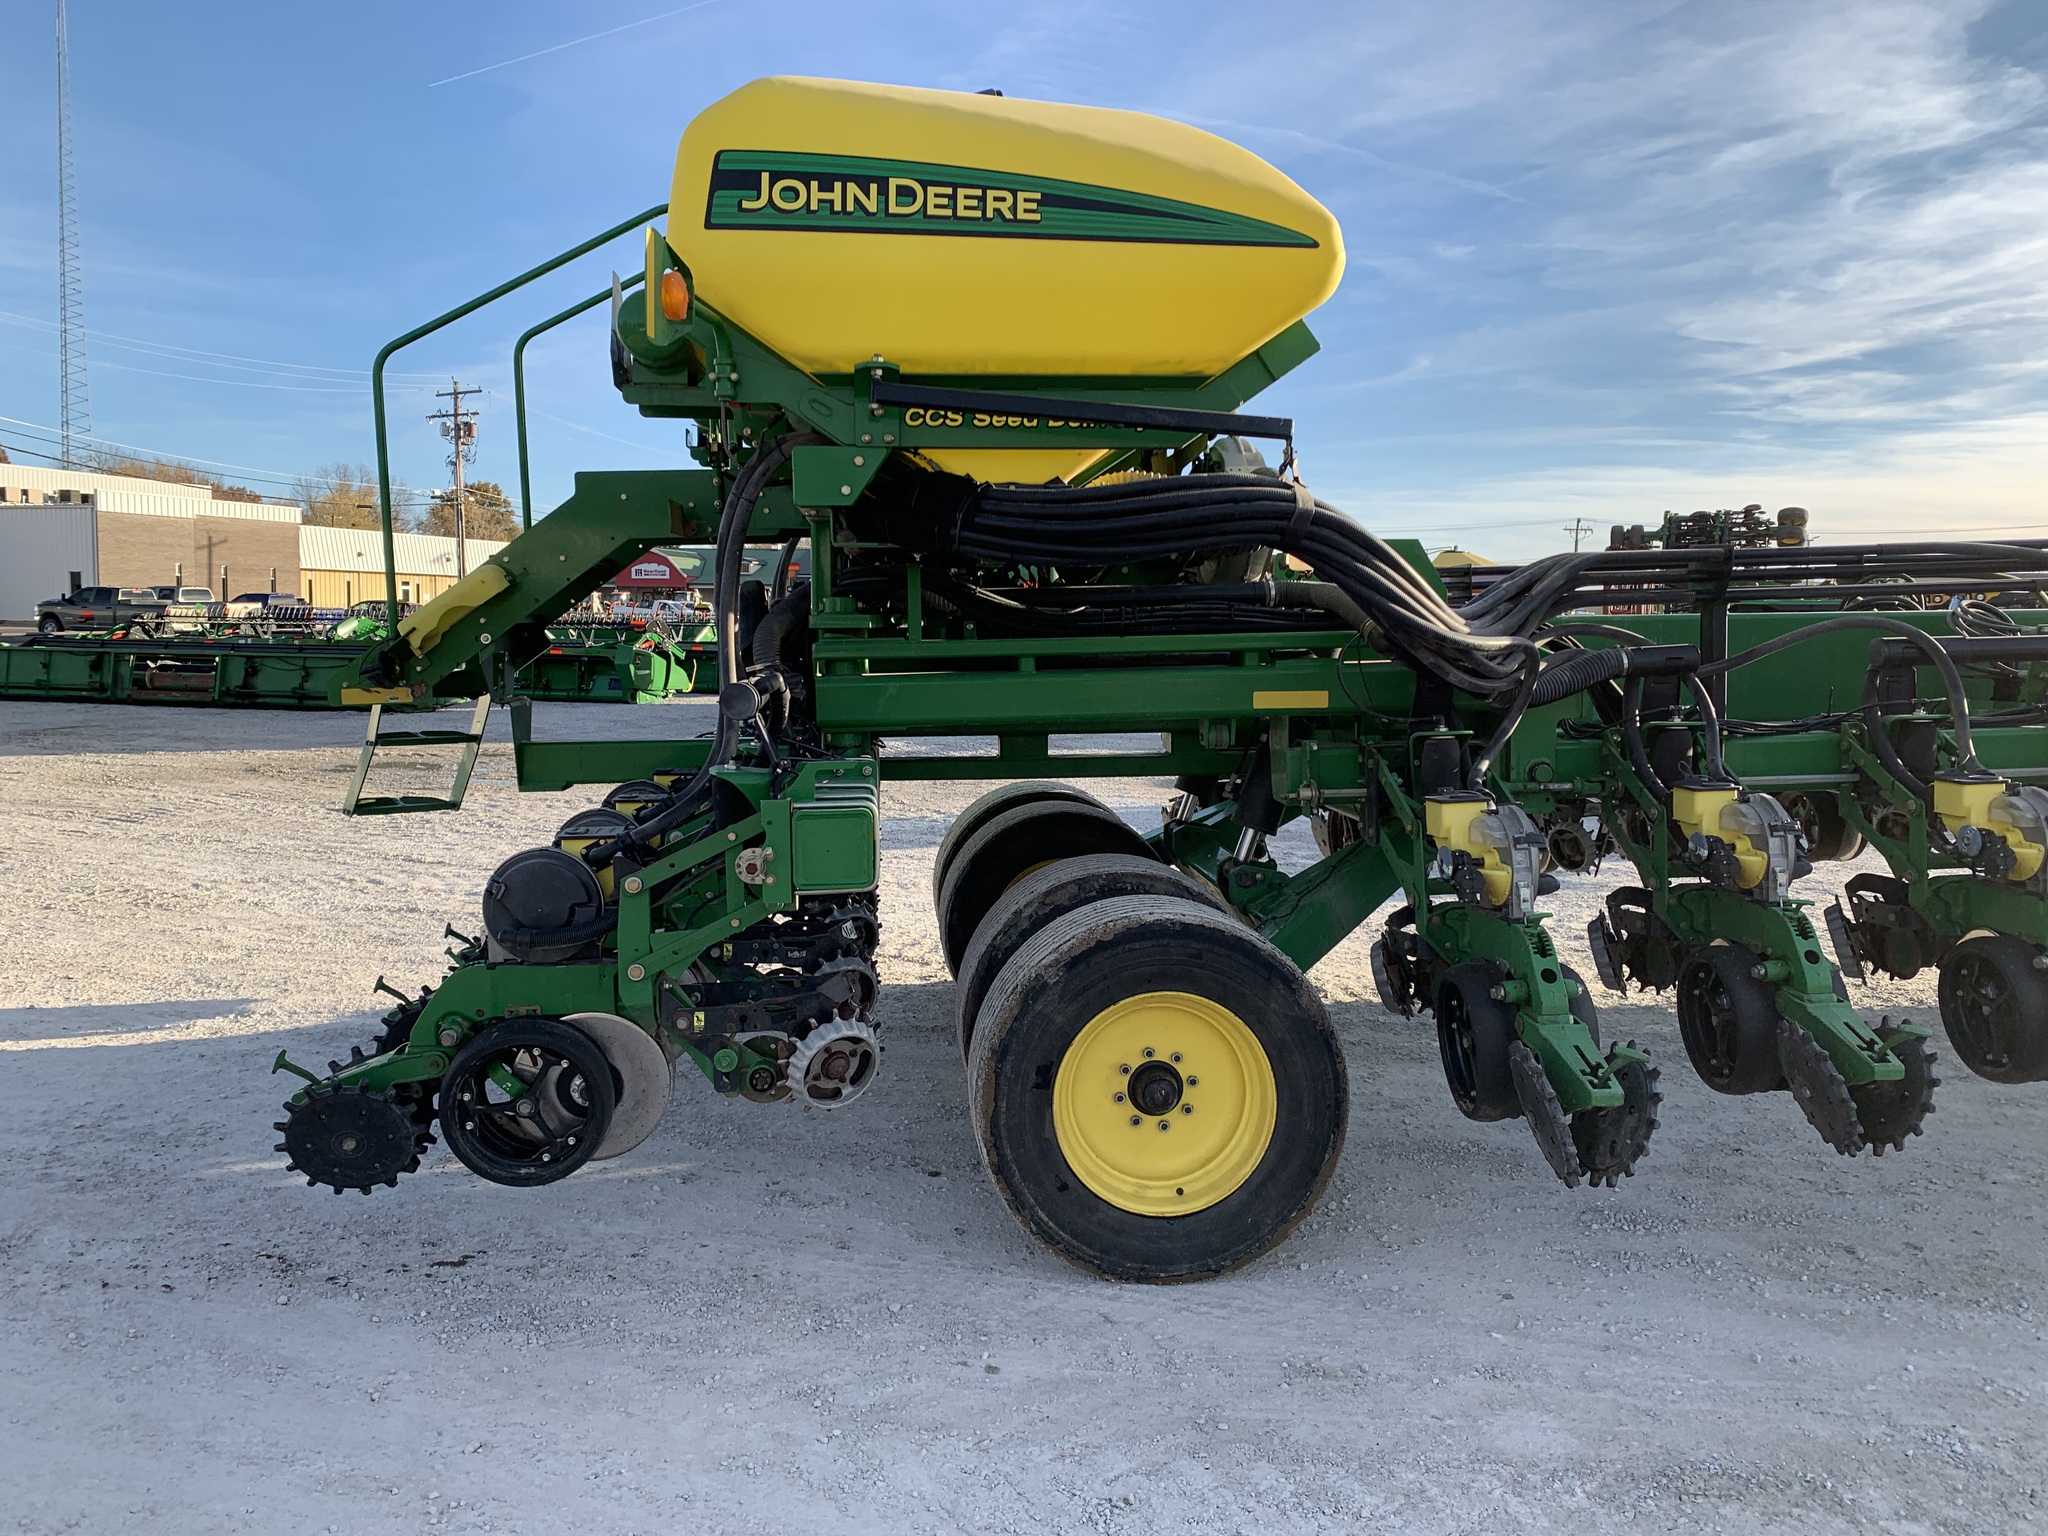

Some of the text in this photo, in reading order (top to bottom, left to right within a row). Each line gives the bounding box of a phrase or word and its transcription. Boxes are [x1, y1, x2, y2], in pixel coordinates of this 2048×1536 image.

[741, 171, 1042, 221] JOHN DEERE
[904, 407, 963, 428] CCS
